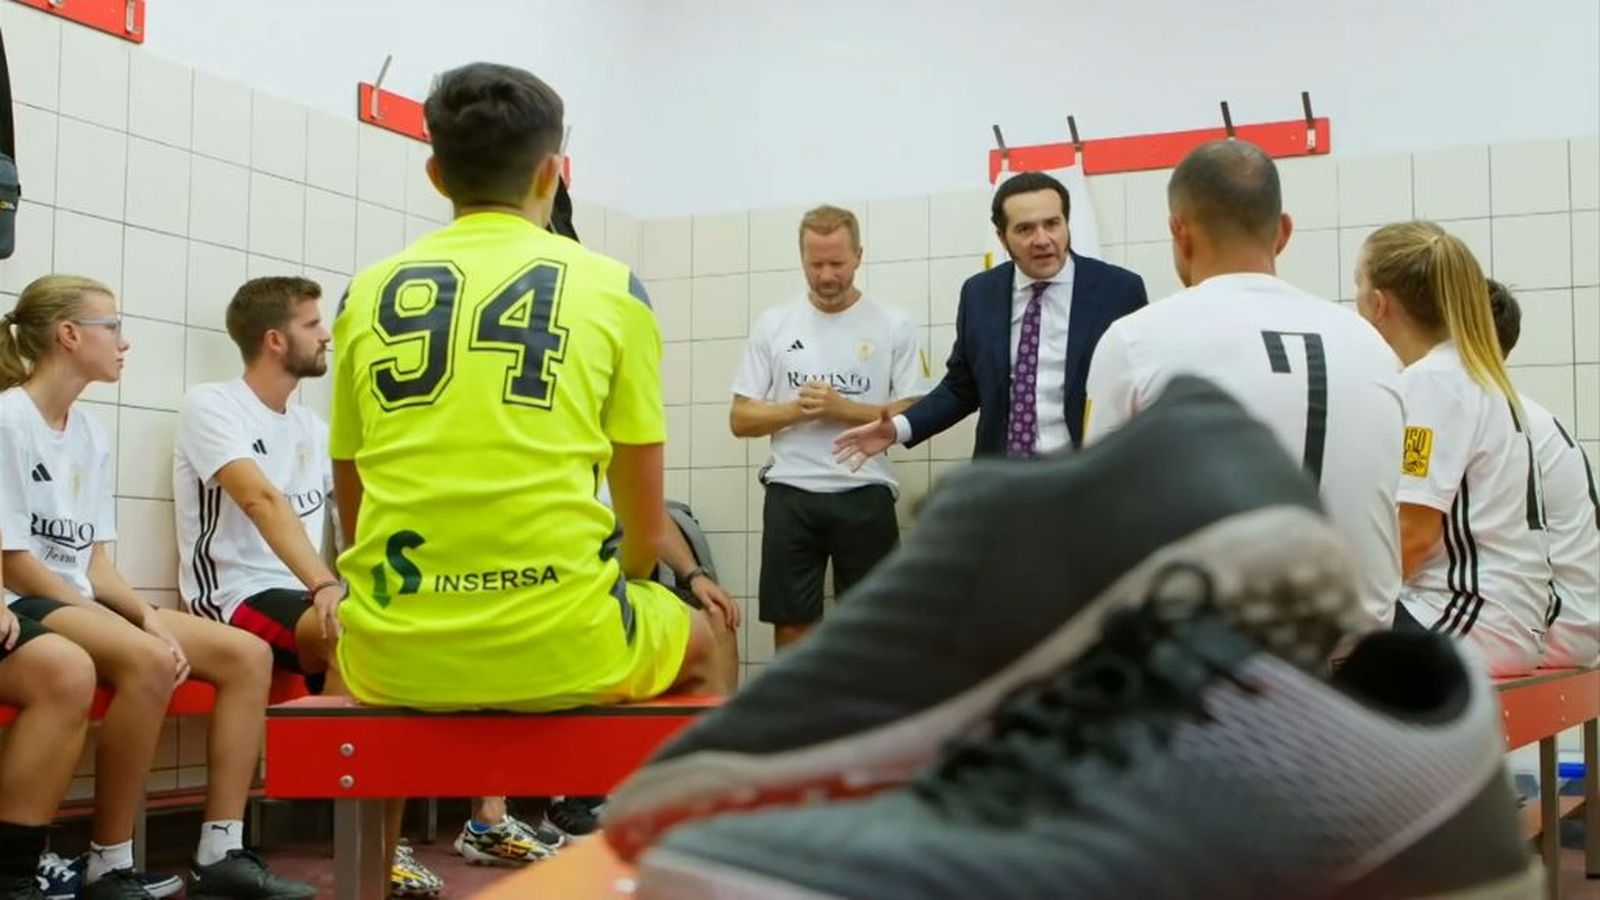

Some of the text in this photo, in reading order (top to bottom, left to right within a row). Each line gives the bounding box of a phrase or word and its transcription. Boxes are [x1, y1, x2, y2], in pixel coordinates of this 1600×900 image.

[369, 257, 570, 412] 94
[1261, 330, 1327, 497] 7
[434, 564, 560, 593] INSERSA
